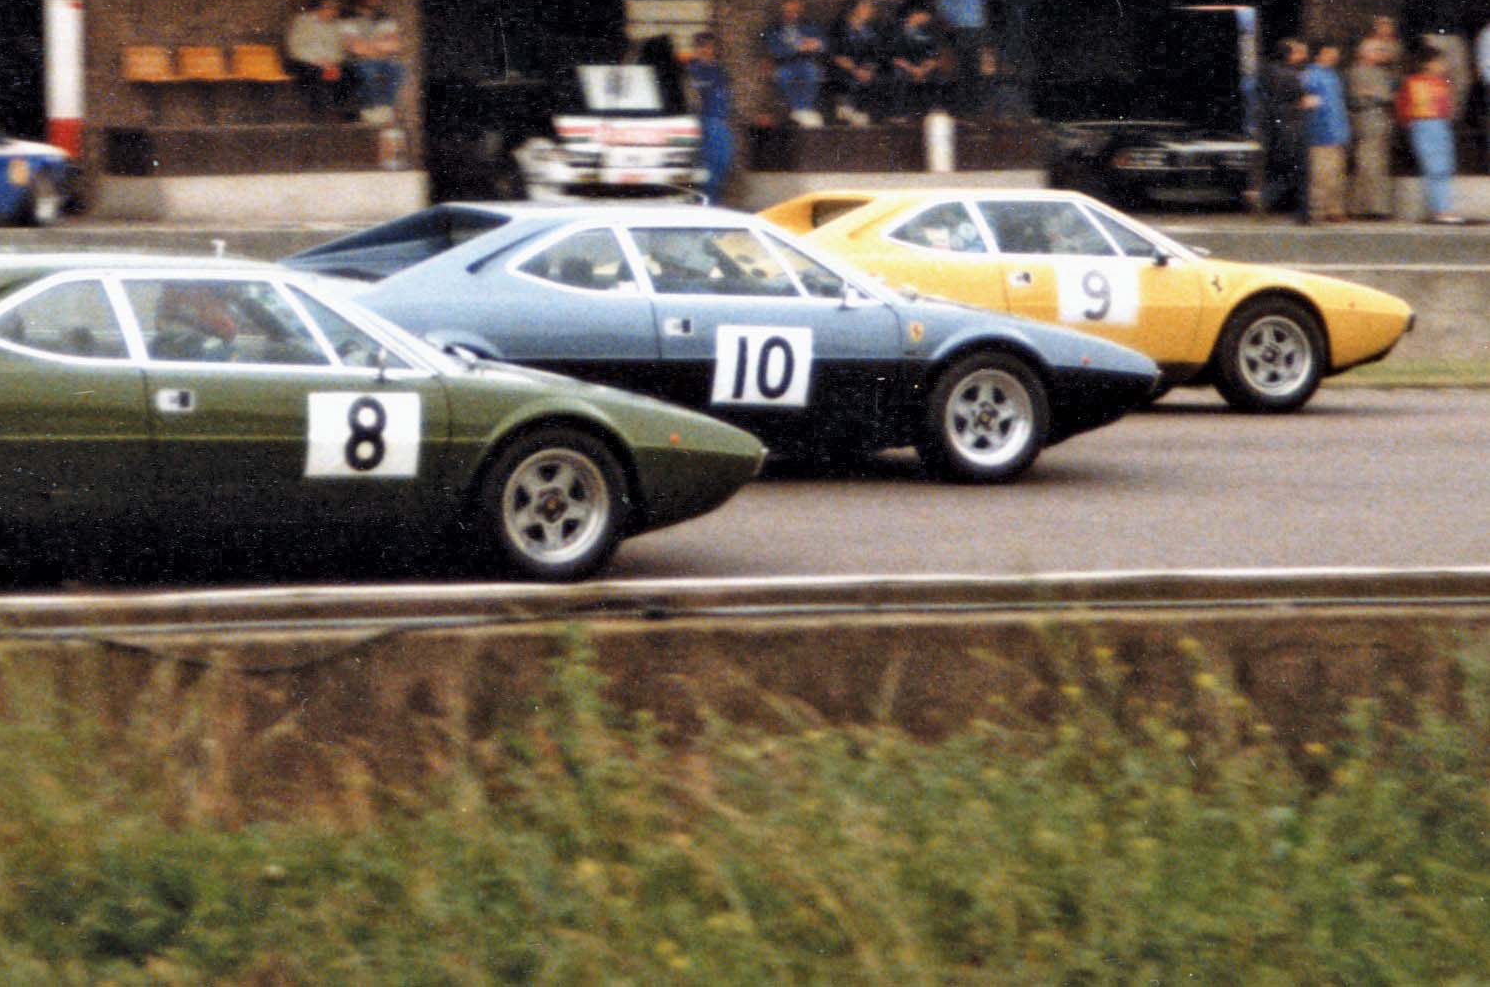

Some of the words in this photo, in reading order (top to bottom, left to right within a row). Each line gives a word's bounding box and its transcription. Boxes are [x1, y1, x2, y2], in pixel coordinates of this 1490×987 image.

[1083, 270, 1112, 321] 9
[731, 335, 795, 399] 10
[345, 397, 386, 471] 8
